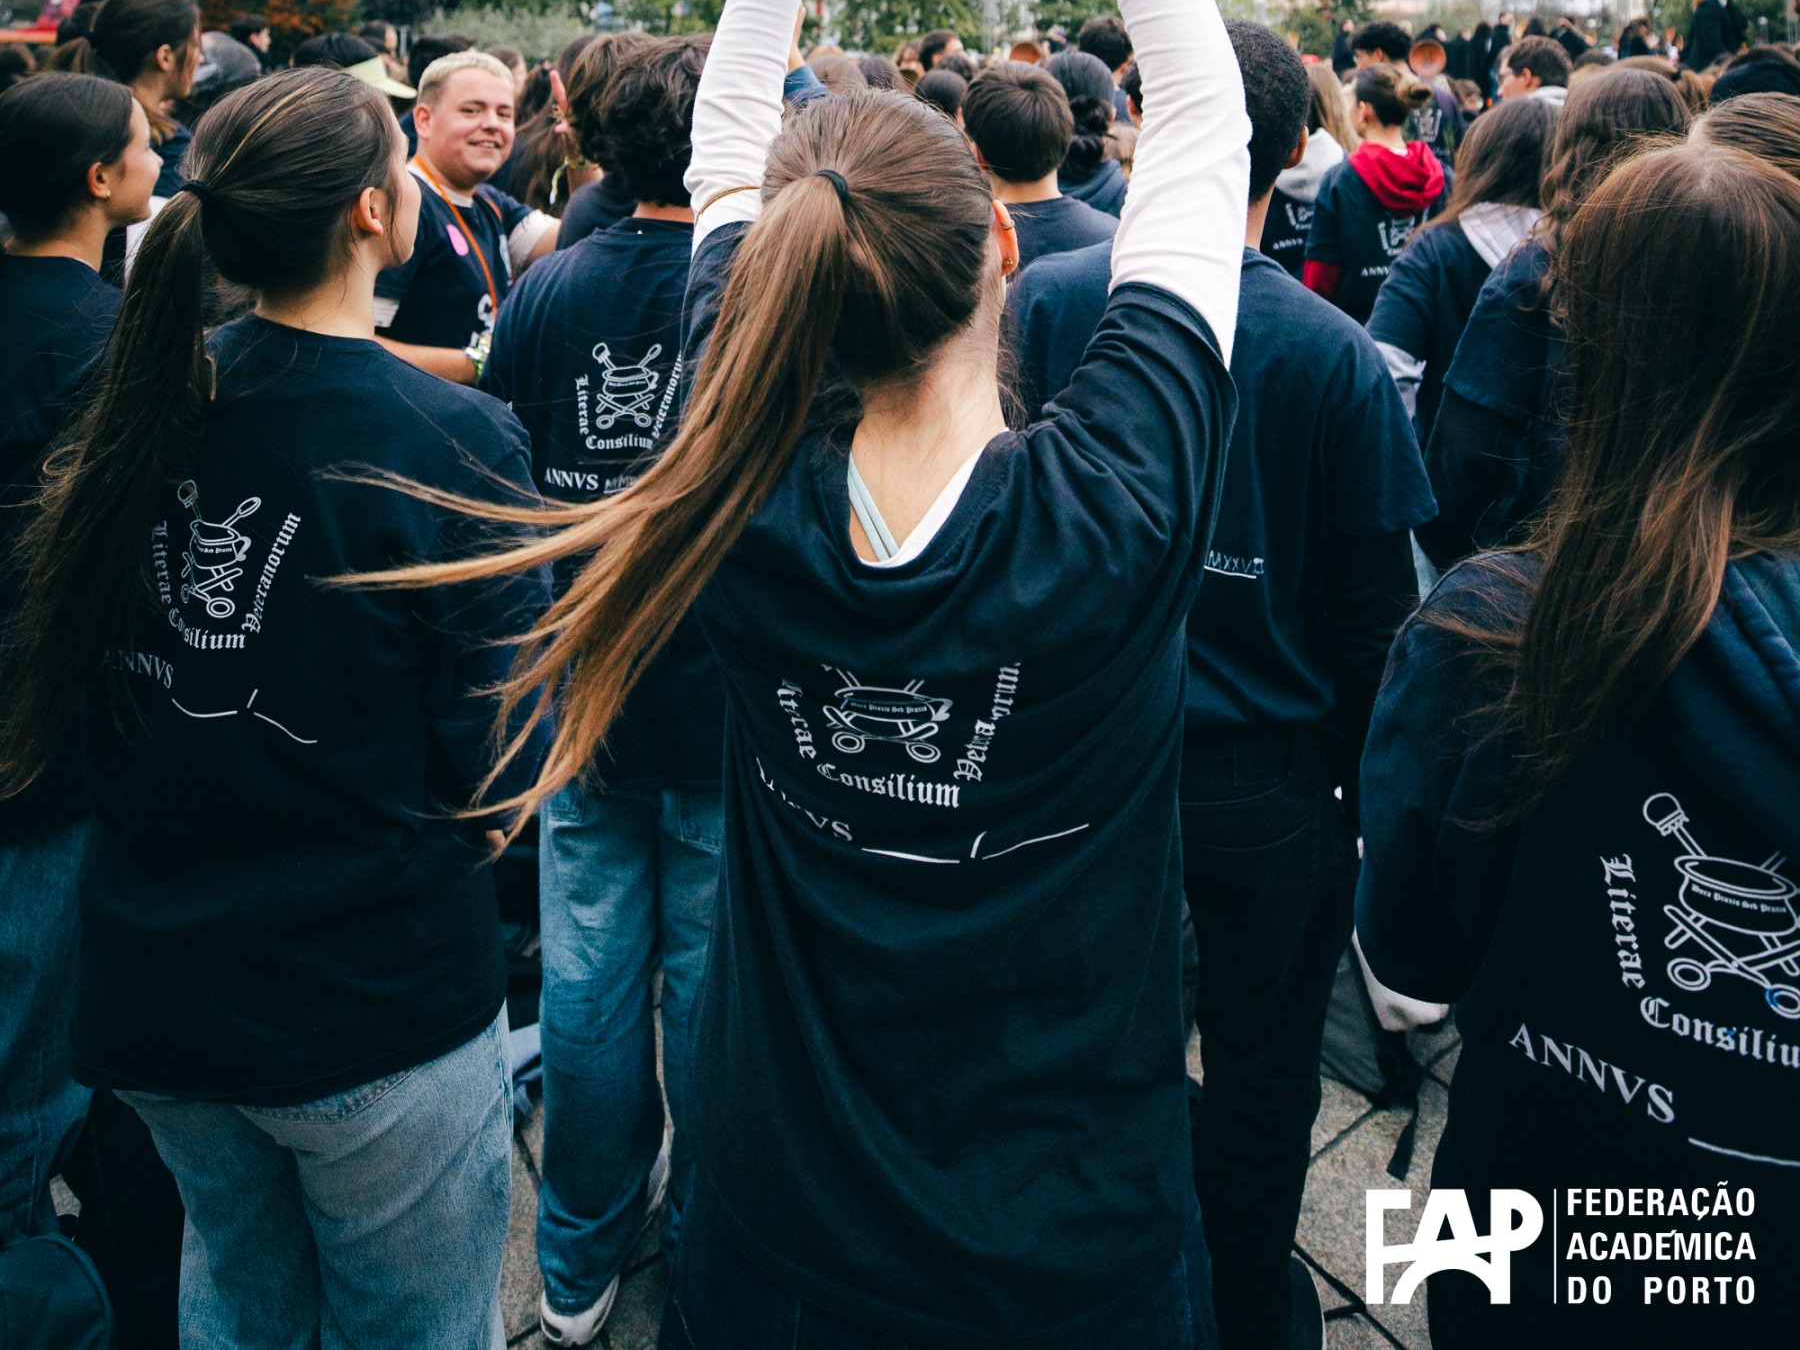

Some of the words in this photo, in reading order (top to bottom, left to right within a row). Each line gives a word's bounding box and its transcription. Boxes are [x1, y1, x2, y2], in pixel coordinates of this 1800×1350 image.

[574, 373, 590, 436] Literae
[585, 433, 654, 451] Consilium
[543, 467, 600, 491] ANNVS
[150, 519, 172, 606] Literae
[168, 607, 247, 651] Cosilium
[241, 511, 302, 635] Veteranorum
[1205, 550, 1265, 575] MXXVII
[816, 761, 961, 810] Consilium
[952, 661, 1022, 783] Vetaorum
[1599, 851, 1648, 990] Literae
[1508, 1021, 1677, 1125] ANNVS
